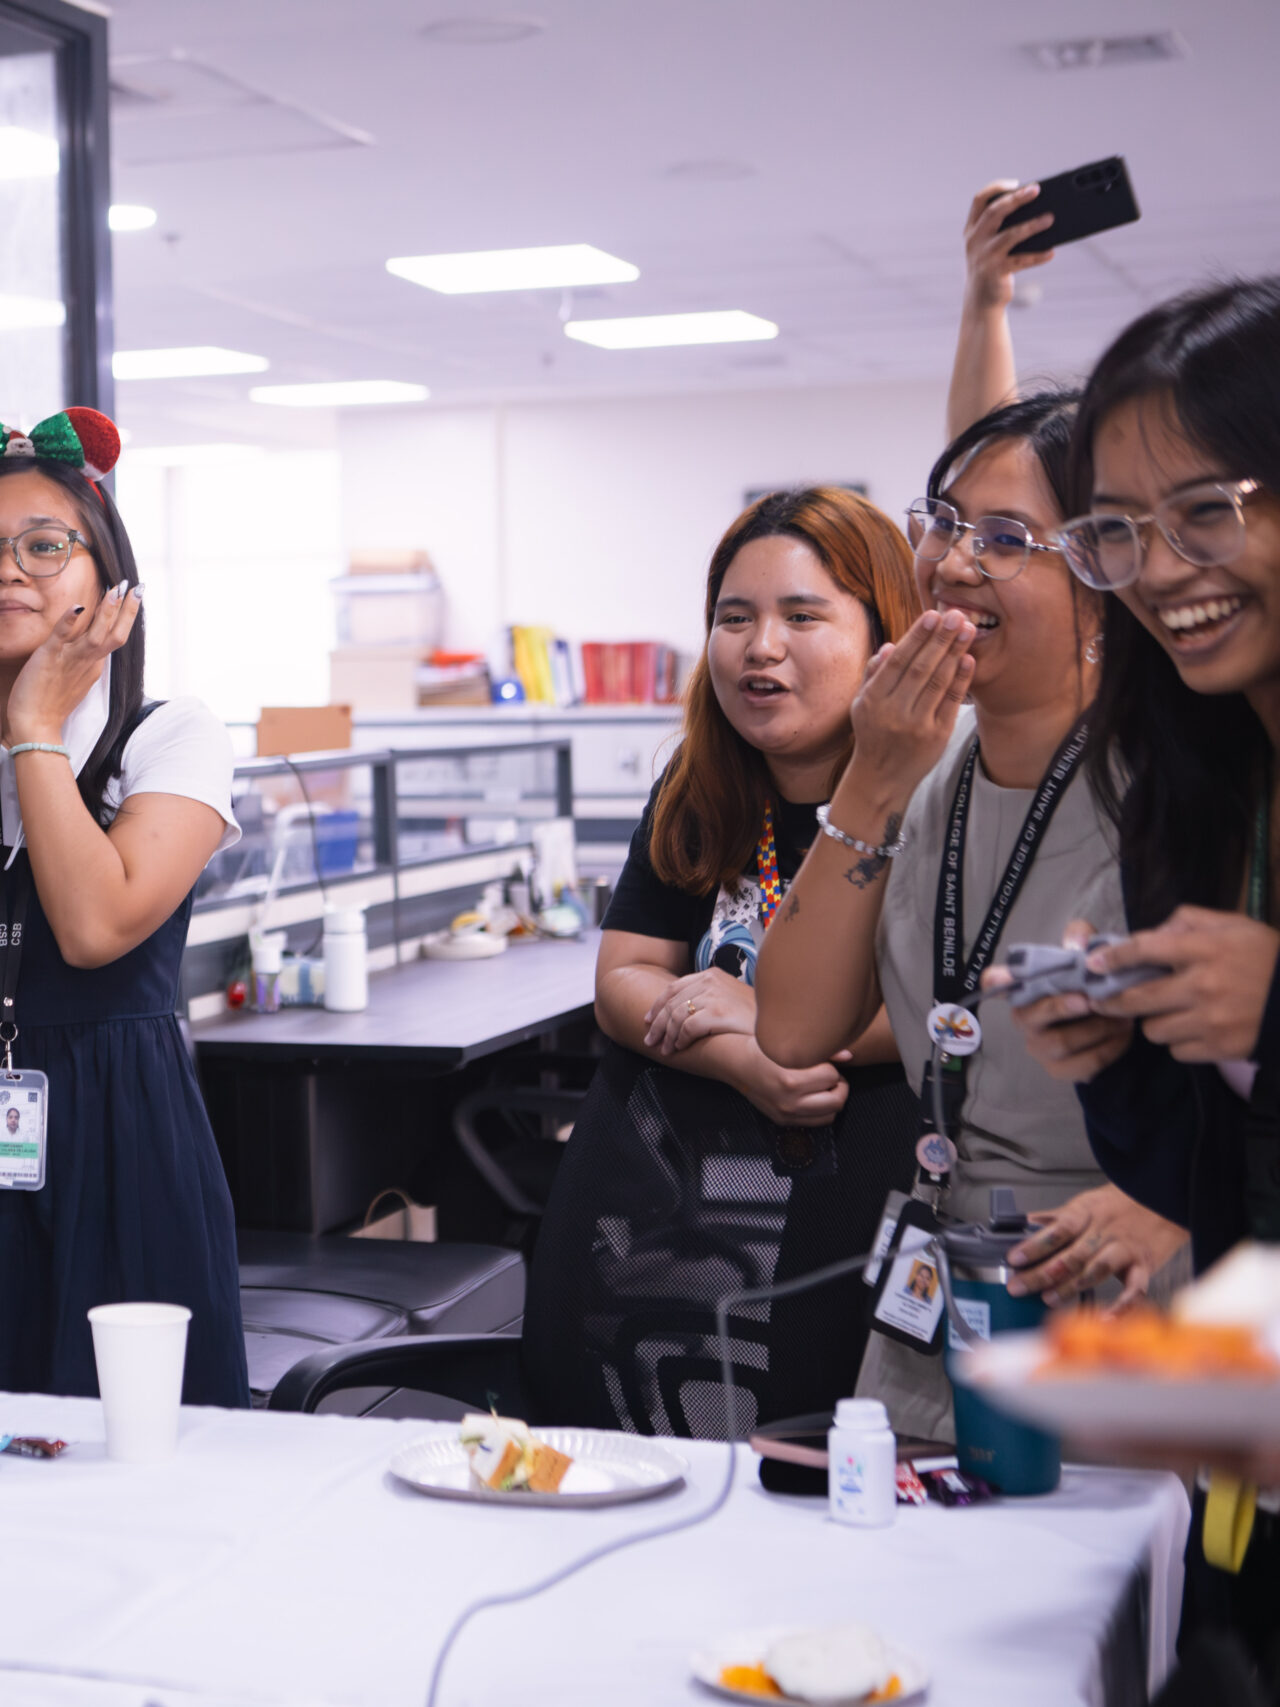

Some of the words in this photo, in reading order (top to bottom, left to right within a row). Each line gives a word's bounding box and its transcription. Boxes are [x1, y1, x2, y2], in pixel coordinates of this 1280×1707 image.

[948, 849, 960, 871] OF
[944, 872, 958, 914] SAINT
[964, 971, 980, 991] DE
[972, 952, 986, 972] LA
[1033, 781, 1056, 821] SAINT
[11, 923, 22, 946] CSB
[942, 916, 957, 977] BENILDE
